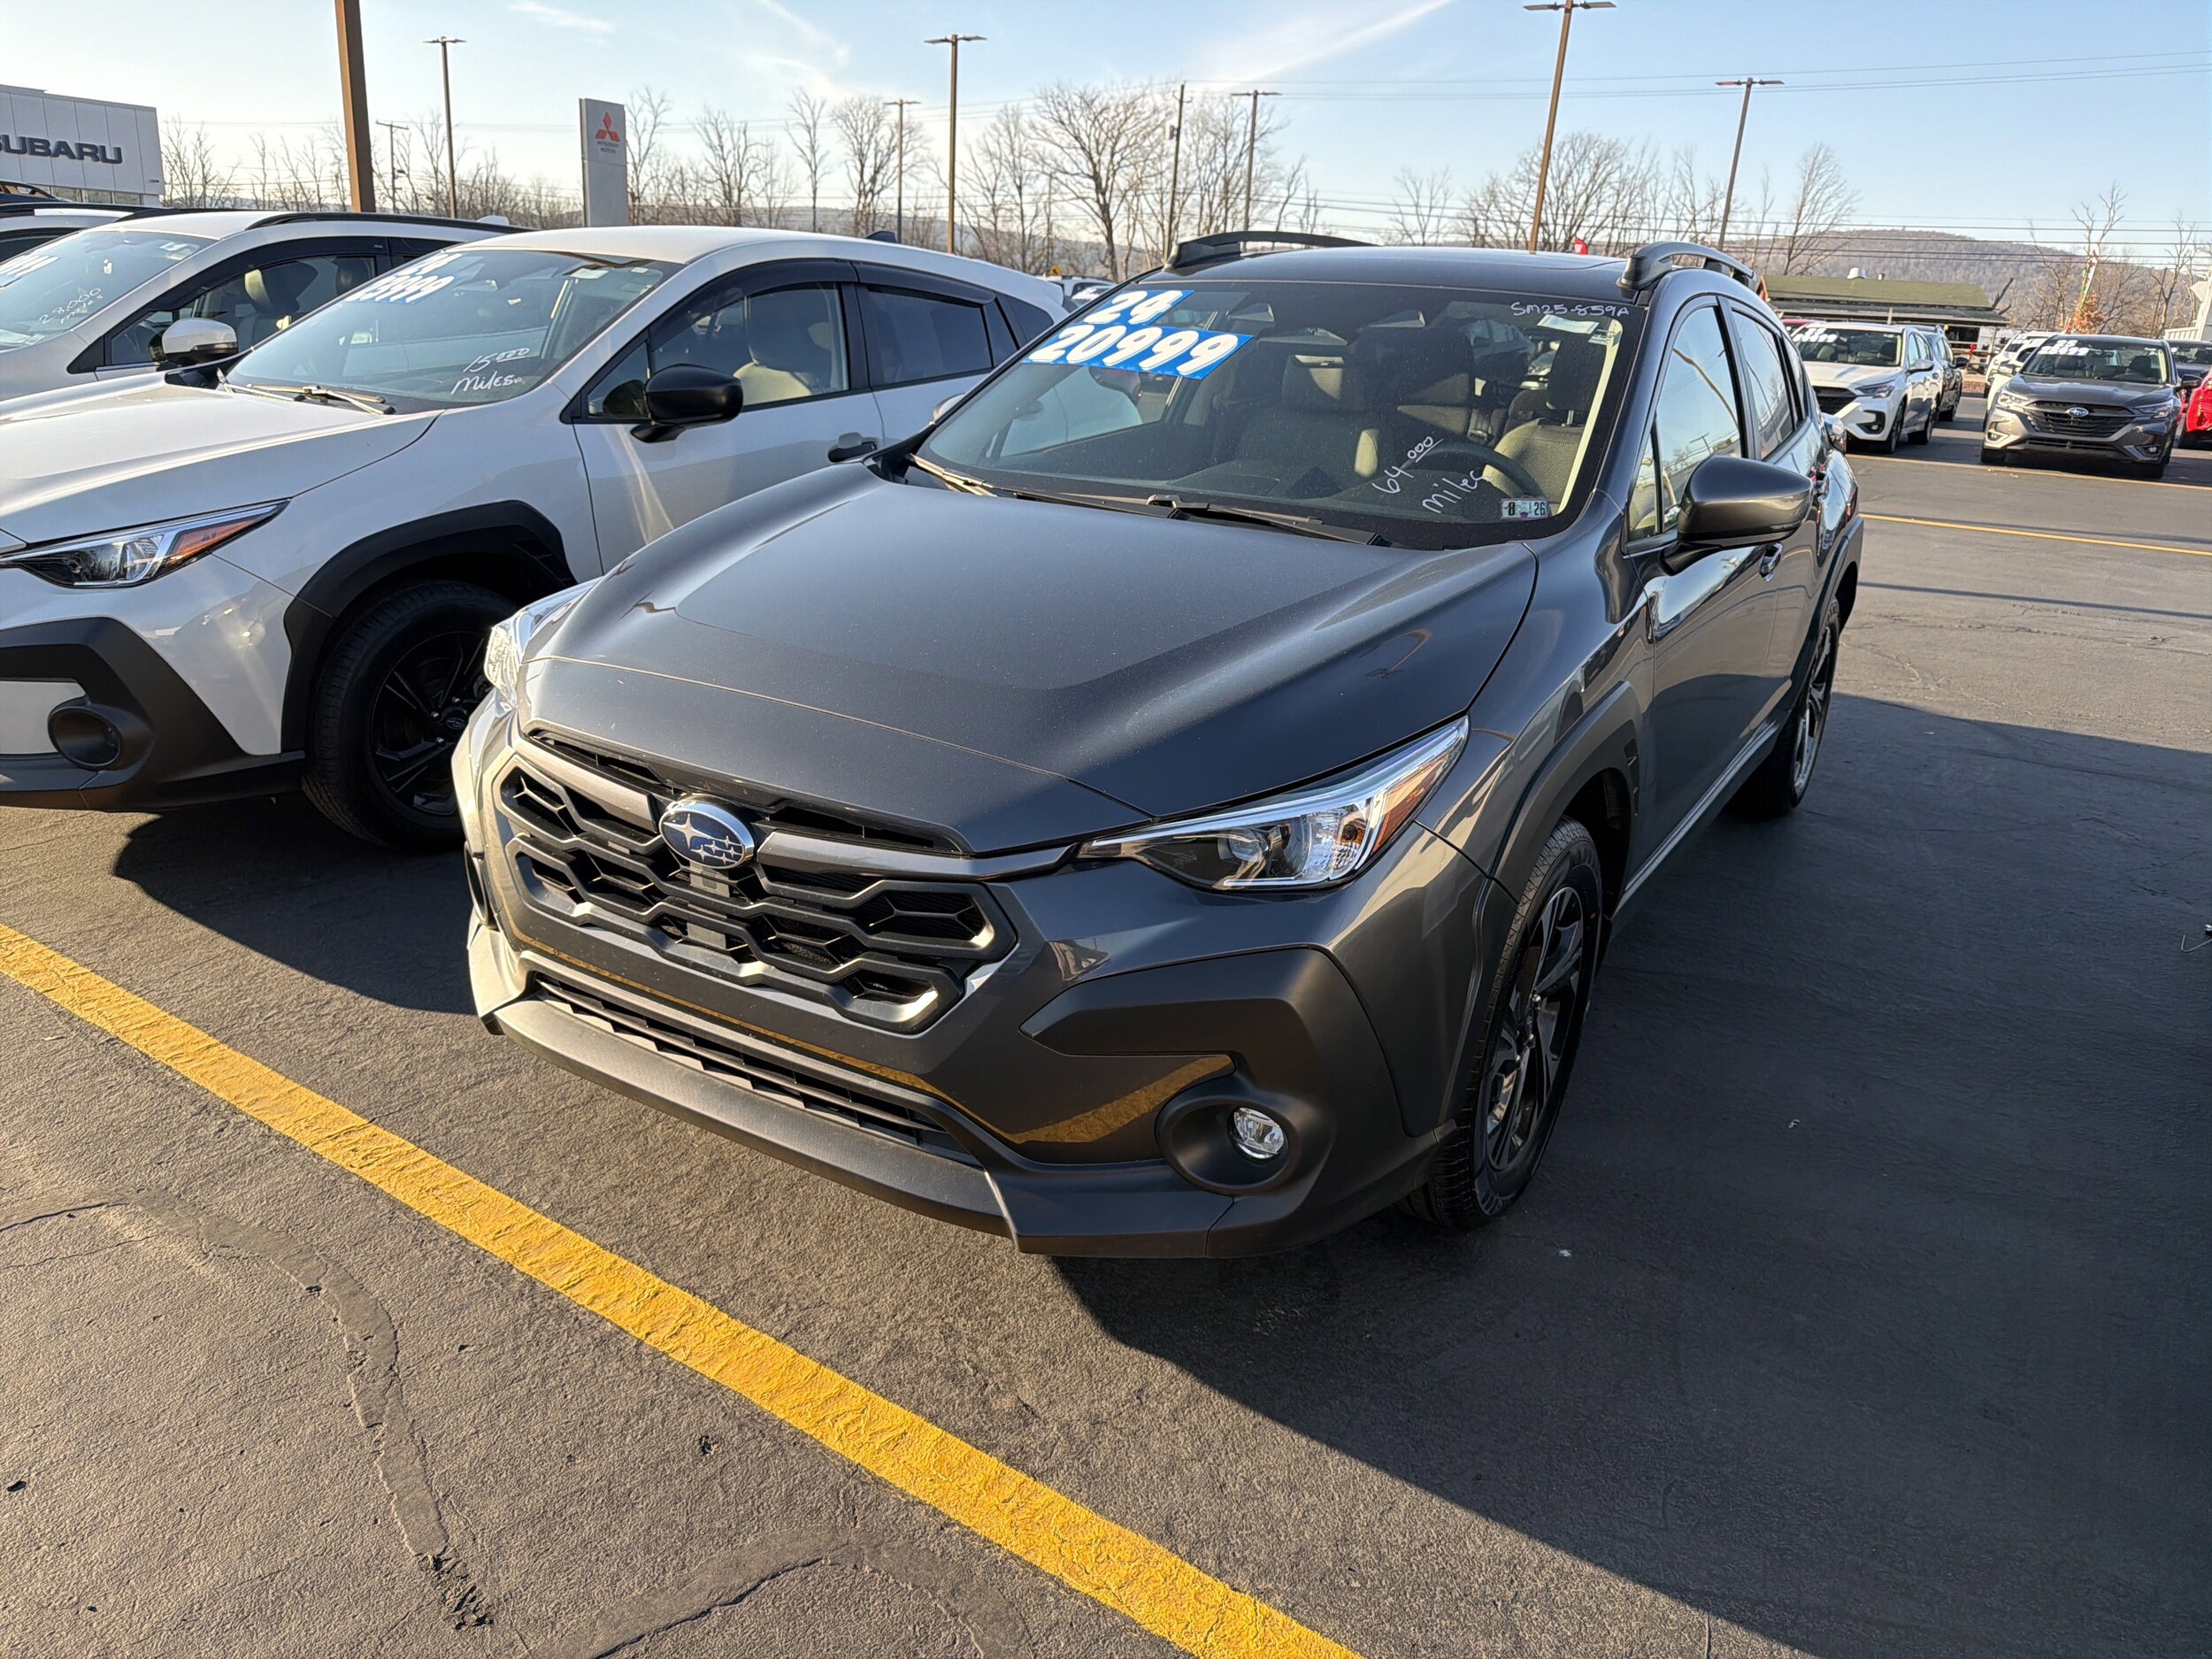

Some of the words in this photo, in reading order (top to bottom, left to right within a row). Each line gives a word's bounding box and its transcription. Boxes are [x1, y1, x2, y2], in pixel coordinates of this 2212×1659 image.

[0, 134, 123, 165] UBARU
[1083, 290, 1184, 325] 24
[1028, 324, 1239, 376] 20999
[1508, 502, 1516, 516] 8
[1533, 502, 1547, 516] 26
